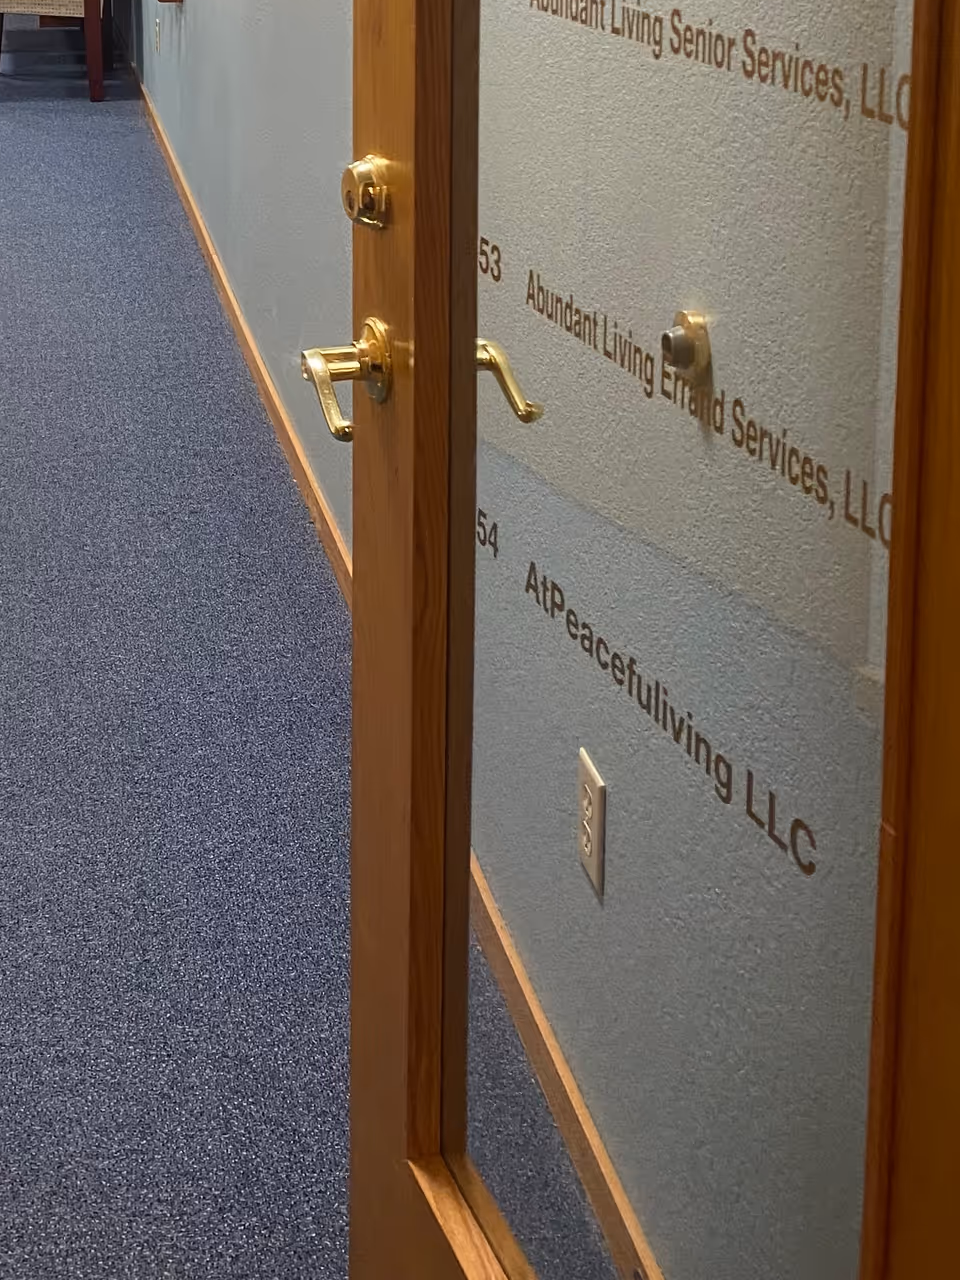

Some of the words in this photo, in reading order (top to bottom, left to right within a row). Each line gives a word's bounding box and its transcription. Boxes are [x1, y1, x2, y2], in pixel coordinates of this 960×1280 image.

[669, 8, 736, 71] Senior
[741, 28, 851, 121] Services,
[860, 62, 912, 132] LLC
[478, 236, 502, 282] 53
[526, 269, 598, 351] Abundant
[603, 314, 655, 400] Living
[731, 397, 836, 521] Services,
[844, 469, 893, 550] LLC
[476, 507, 499, 558] 54
[525, 561, 733, 805] AtPeacefuliving
[746, 769, 817, 876] LLC
